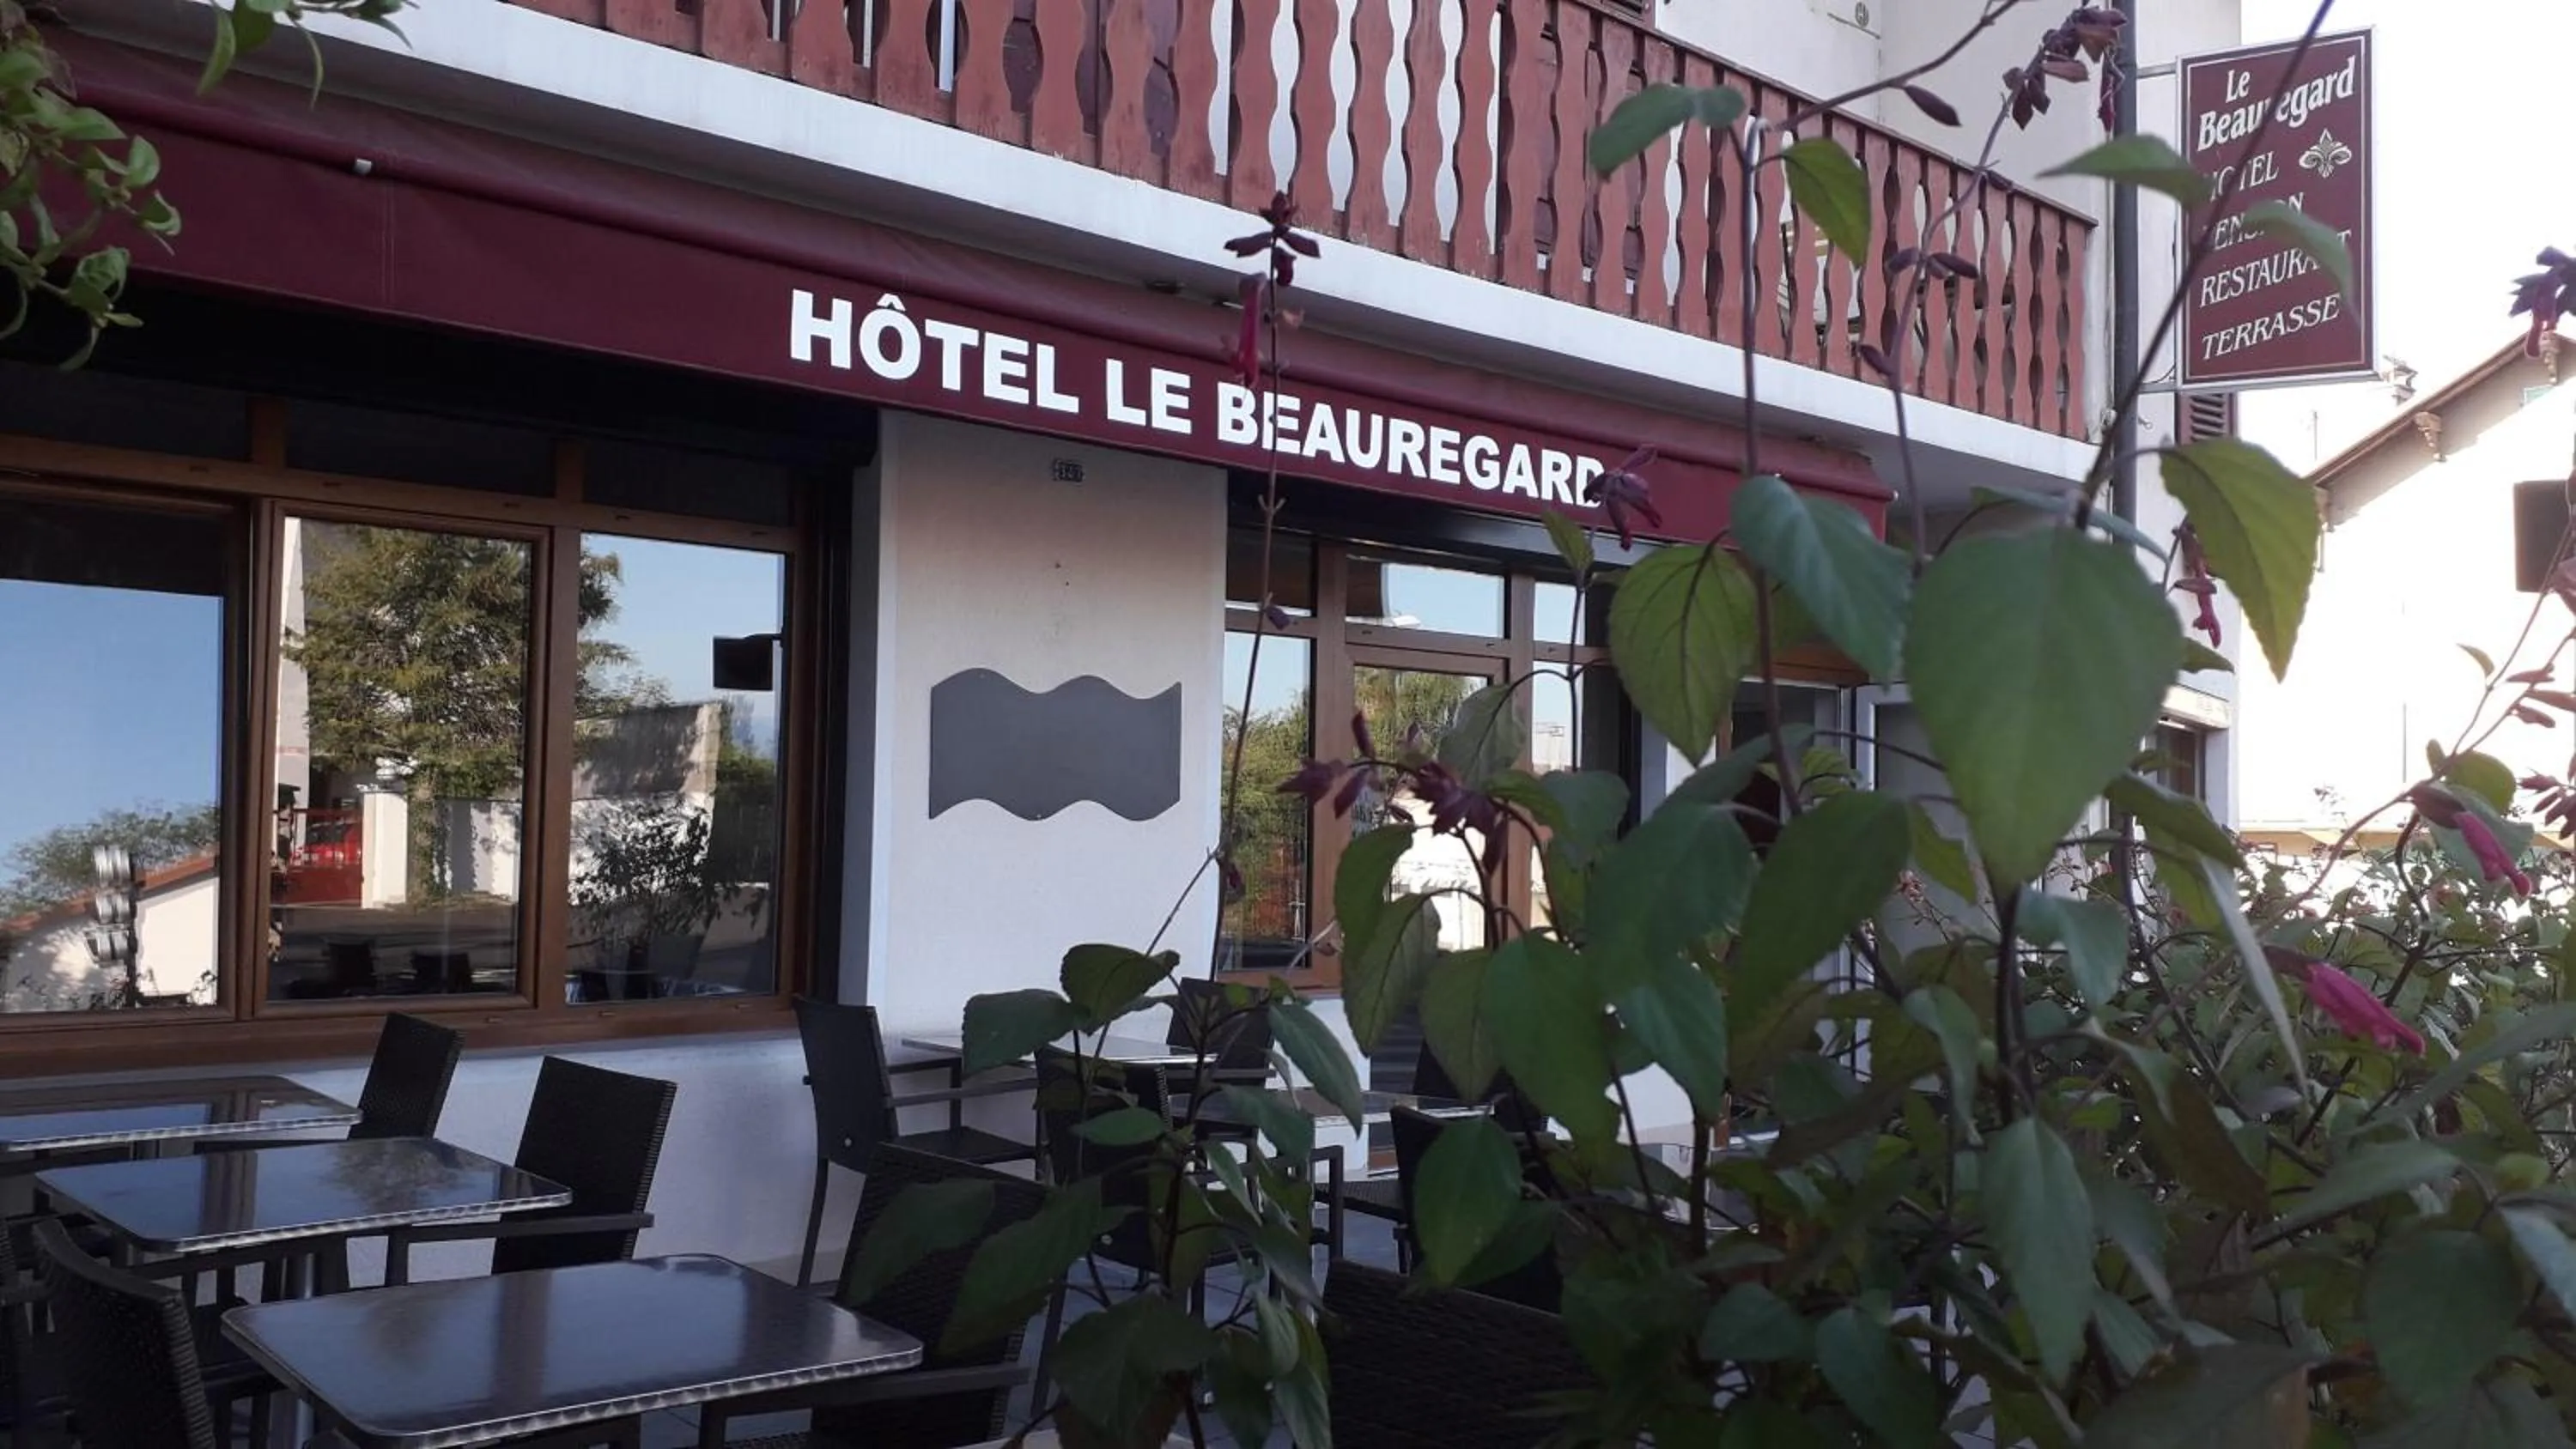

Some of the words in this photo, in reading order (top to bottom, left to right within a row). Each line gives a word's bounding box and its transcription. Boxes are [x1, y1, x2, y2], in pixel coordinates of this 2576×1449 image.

[2226, 70, 2251, 103] Le
[2200, 229, 2352, 308] RESTAURT
[2202, 294, 2341, 360] TERRASSE
[791, 288, 1078, 414] HÔTEL
[1107, 358, 1192, 434] LE
[1217, 382, 1605, 508] BEAUREGARD
